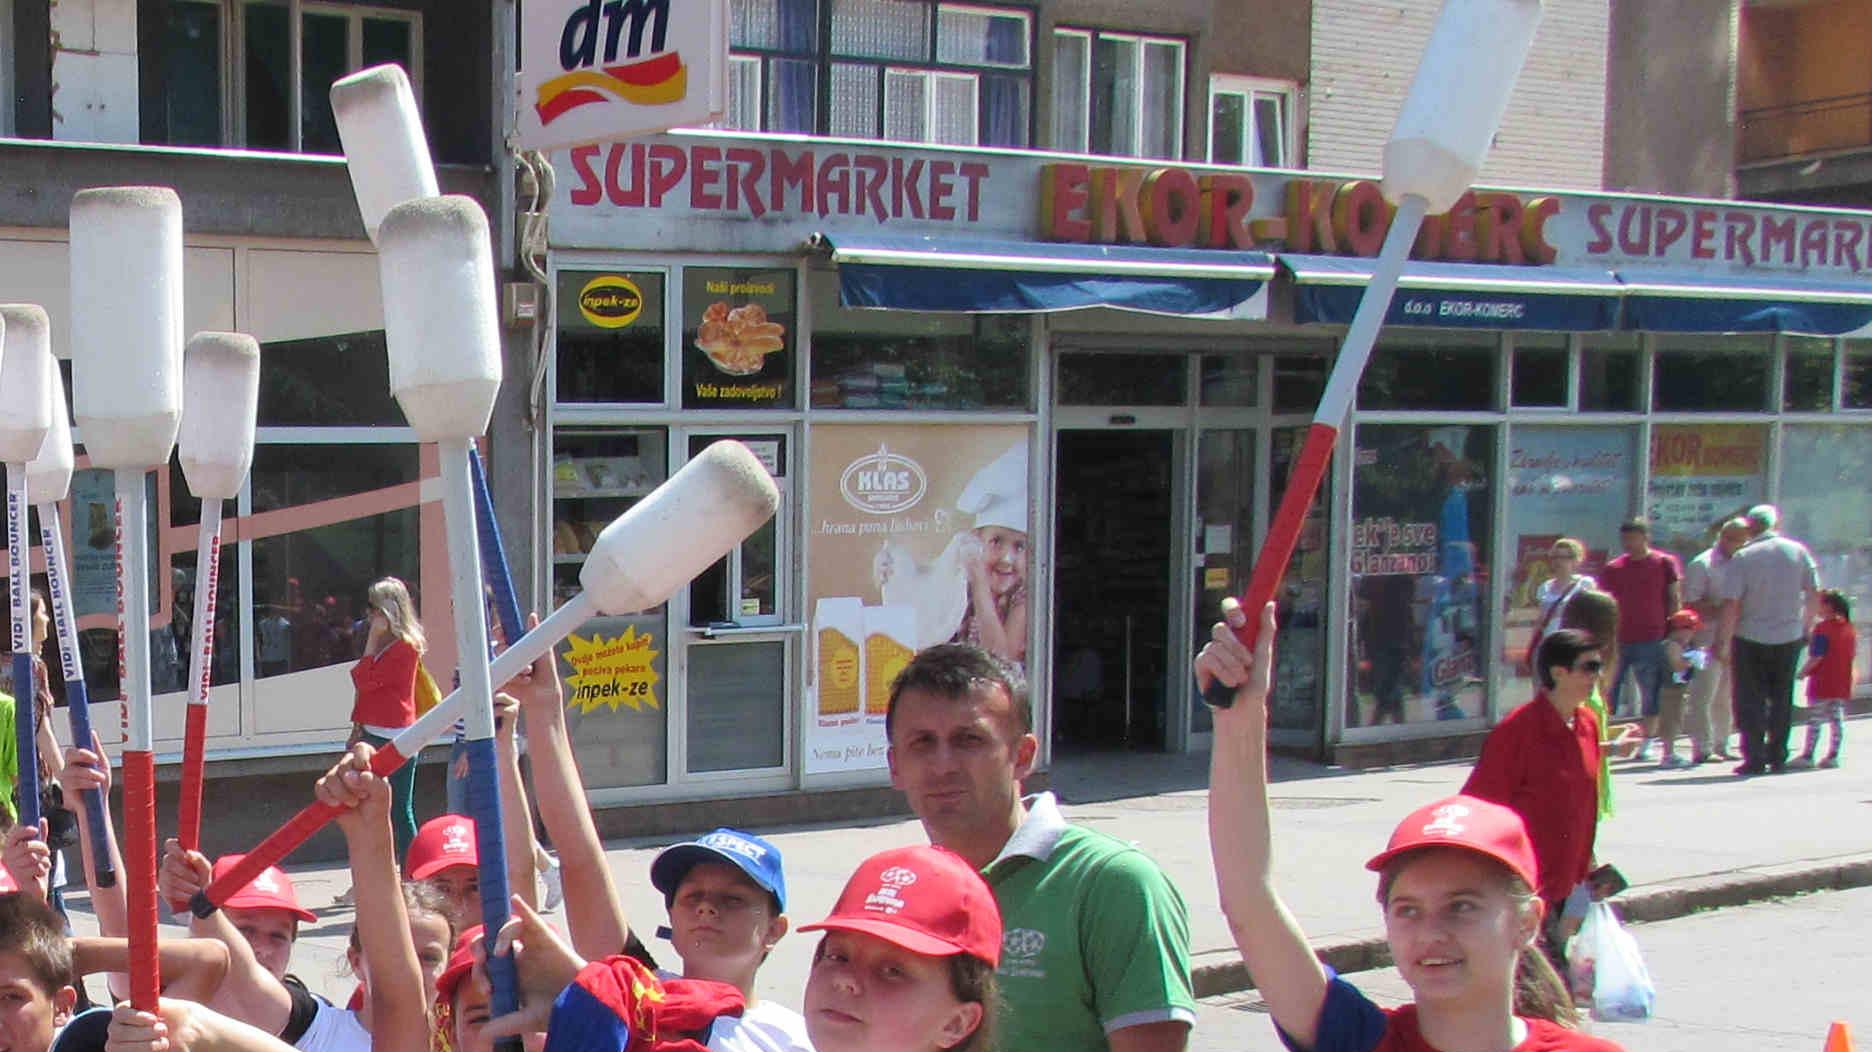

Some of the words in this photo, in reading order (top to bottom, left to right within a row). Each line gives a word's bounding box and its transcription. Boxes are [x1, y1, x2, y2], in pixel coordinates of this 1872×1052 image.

[560, 0, 668, 71] dm
[569, 143, 990, 225] SUPERMARKET
[1586, 202, 1872, 274] SUPERMAR
[1440, 301, 1525, 318] EKOR-KOMERC
[857, 471, 909, 490] KLAS
[9, 492, 20, 565] BOUNCER
[11, 570, 22, 608] BALL
[42, 528, 62, 597] BOUNCER
[54, 601, 68, 638] BALL
[576, 677, 649, 703] inpek-ze
